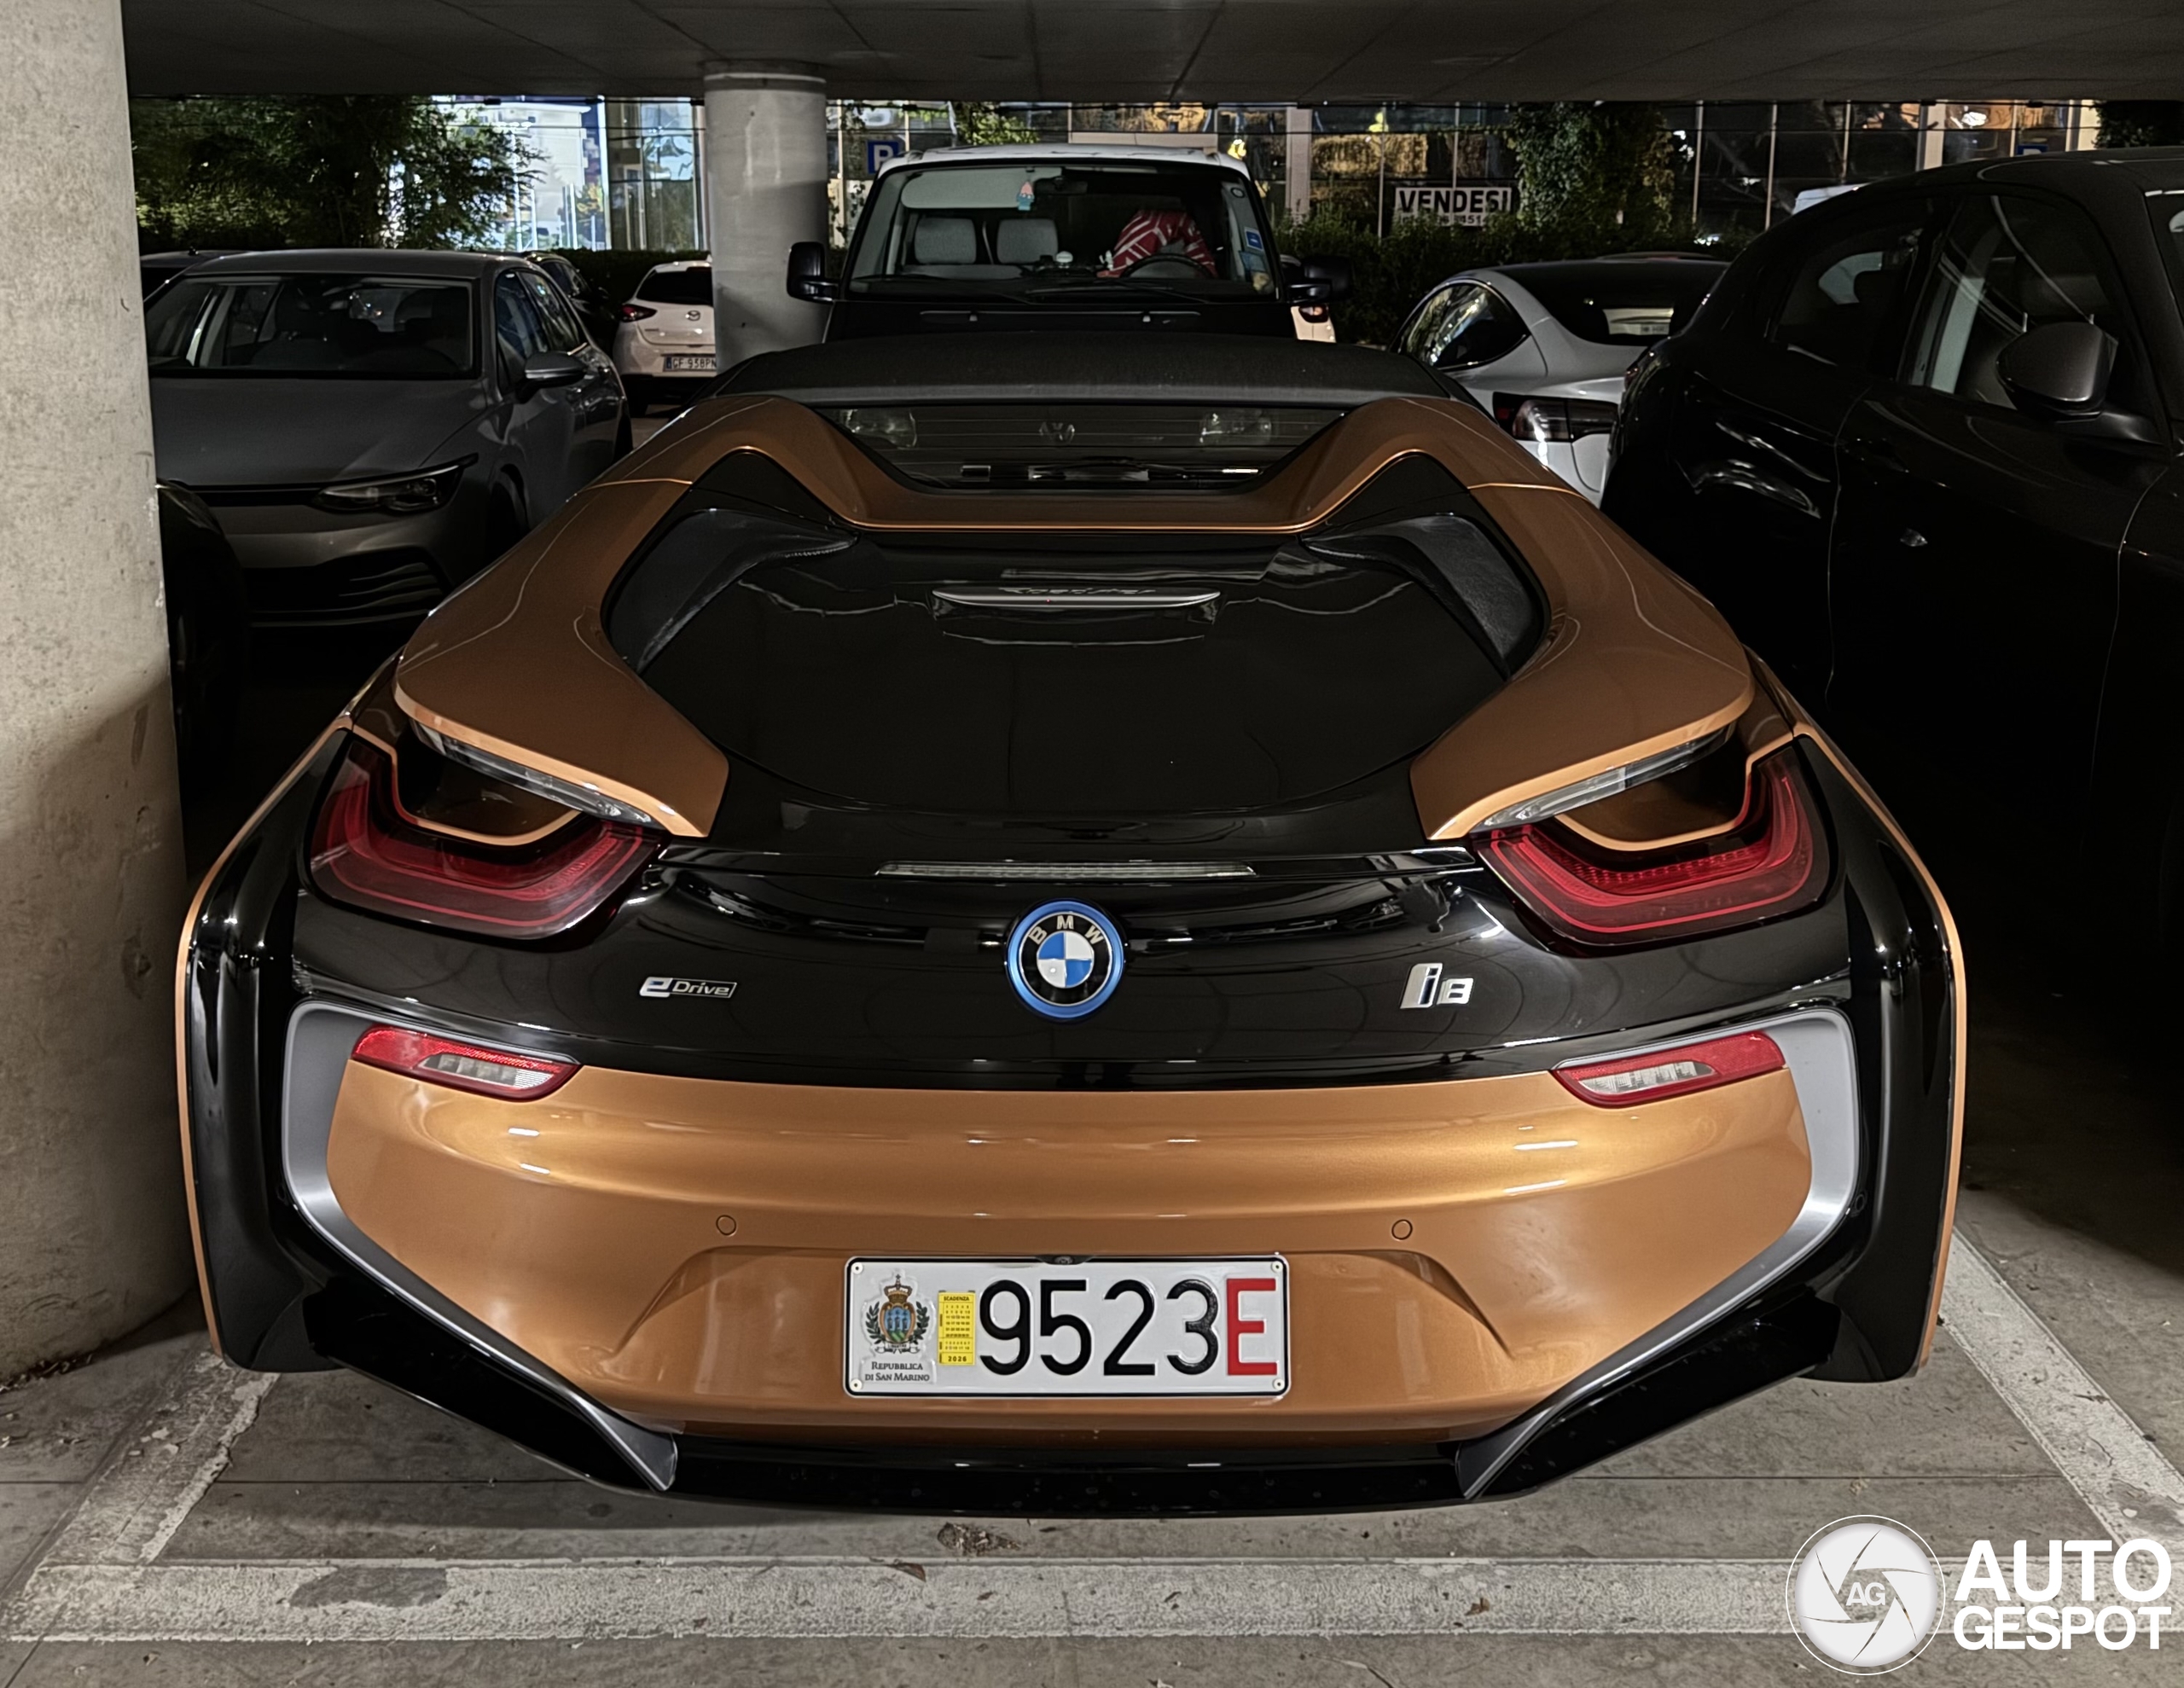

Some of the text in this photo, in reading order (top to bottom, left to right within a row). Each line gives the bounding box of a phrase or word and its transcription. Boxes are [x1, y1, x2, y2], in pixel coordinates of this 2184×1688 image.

[874, 144, 894, 171] P
[1398, 190, 1508, 213] VENDESI
[1028, 914, 1105, 945] BMW
[1400, 962, 1474, 1009] i8
[979, 1277, 1279, 1377] 9523E
